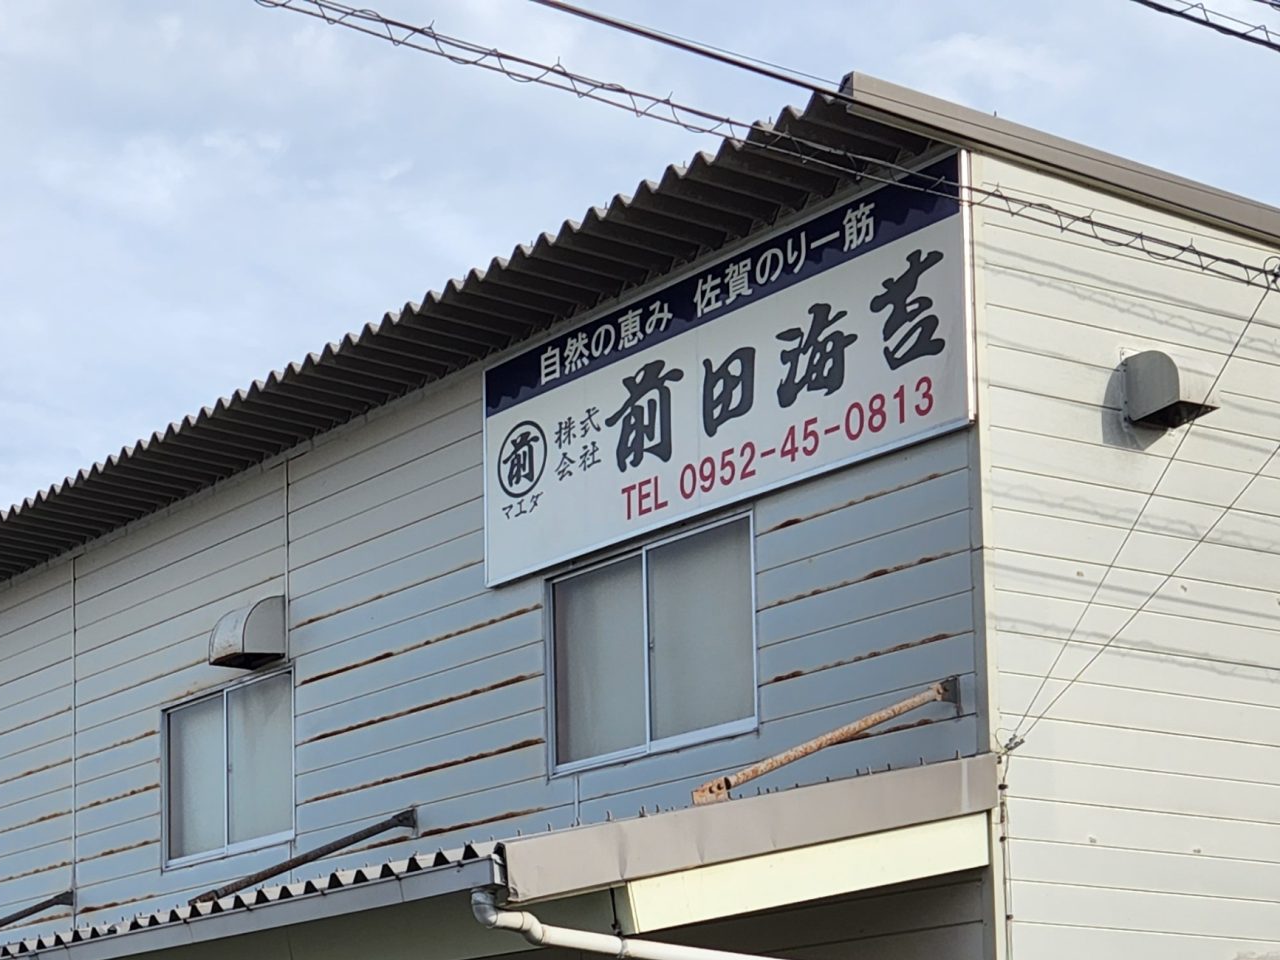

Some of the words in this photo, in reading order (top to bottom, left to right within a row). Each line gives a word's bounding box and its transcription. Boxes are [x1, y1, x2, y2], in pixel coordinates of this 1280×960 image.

[538, 299, 673, 387] 自然の恵み
[693, 201, 877, 318] 佐賀のり一筋
[605, 248, 946, 473] 前田海苔
[500, 427, 543, 489] 前
[553, 406, 601, 448] 株式
[621, 481, 669, 521] TEL
[679, 375, 935, 500] 0952-45-0813
[553, 441, 602, 481] 会社
[500, 491, 544, 521] マエダ
